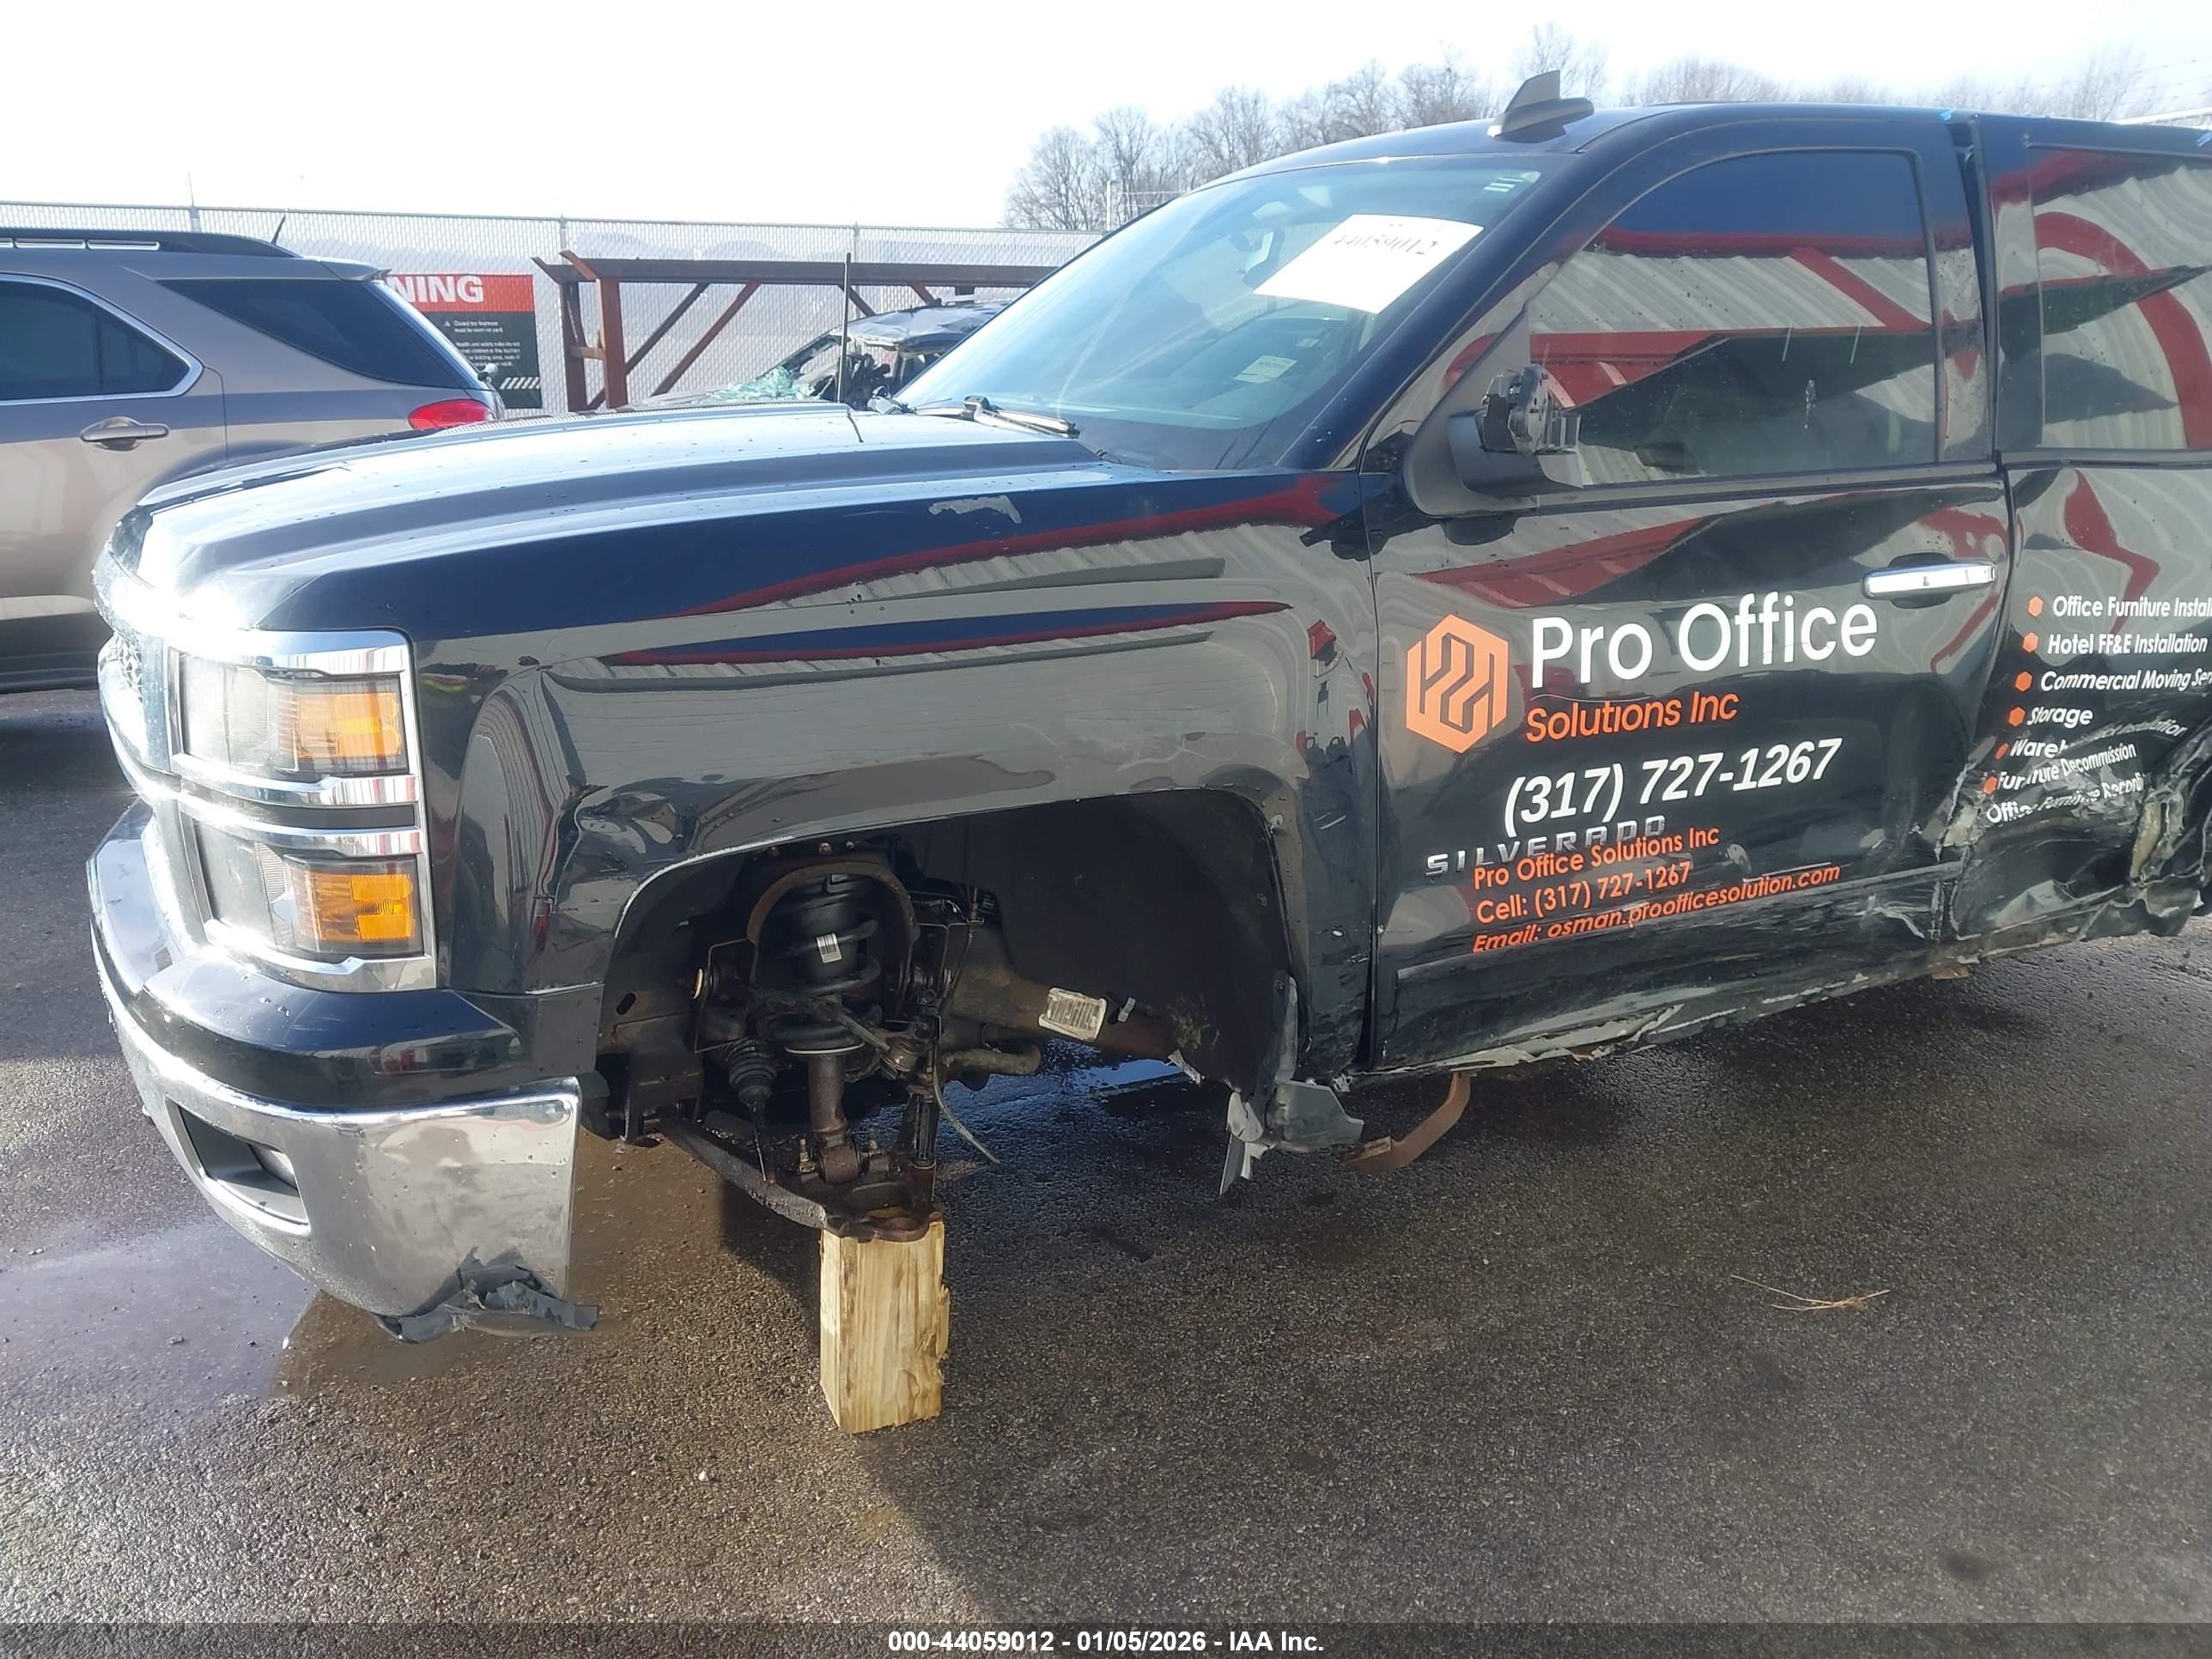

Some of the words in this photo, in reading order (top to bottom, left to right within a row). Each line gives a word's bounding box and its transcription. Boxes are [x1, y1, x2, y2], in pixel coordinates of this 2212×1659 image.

[2053, 595, 2103, 617] Office
[2107, 596, 2171, 617] Furniture
[1532, 617, 1652, 689] Pro
[1678, 592, 1878, 672] Office
[2047, 633, 2094, 654] Hotel
[2098, 634, 2132, 654] FF&E
[2134, 633, 2208, 653] Installation
[2040, 671, 2142, 691] Commercial
[2142, 669, 2191, 691] Moving
[1526, 692, 1682, 743] Solutions
[1690, 690, 1741, 723] Inc
[2027, 707, 2094, 729] Storage
[2060, 743, 2136, 777] Decommission
[1504, 763, 1624, 837] (317)
[1639, 738, 1844, 805] 727-1267
[1425, 815, 1665, 876] SILVERADO
[1474, 865, 1510, 890] Pro
[1516, 853, 1583, 881] Office
[1591, 835, 1683, 867] Solutions
[1689, 826, 1720, 848] Inc
[1476, 896, 1528, 924] Cell:
[1534, 880, 1591, 918] (317)
[1597, 861, 1692, 900] 727-1267
[1472, 923, 1540, 953] Email:
